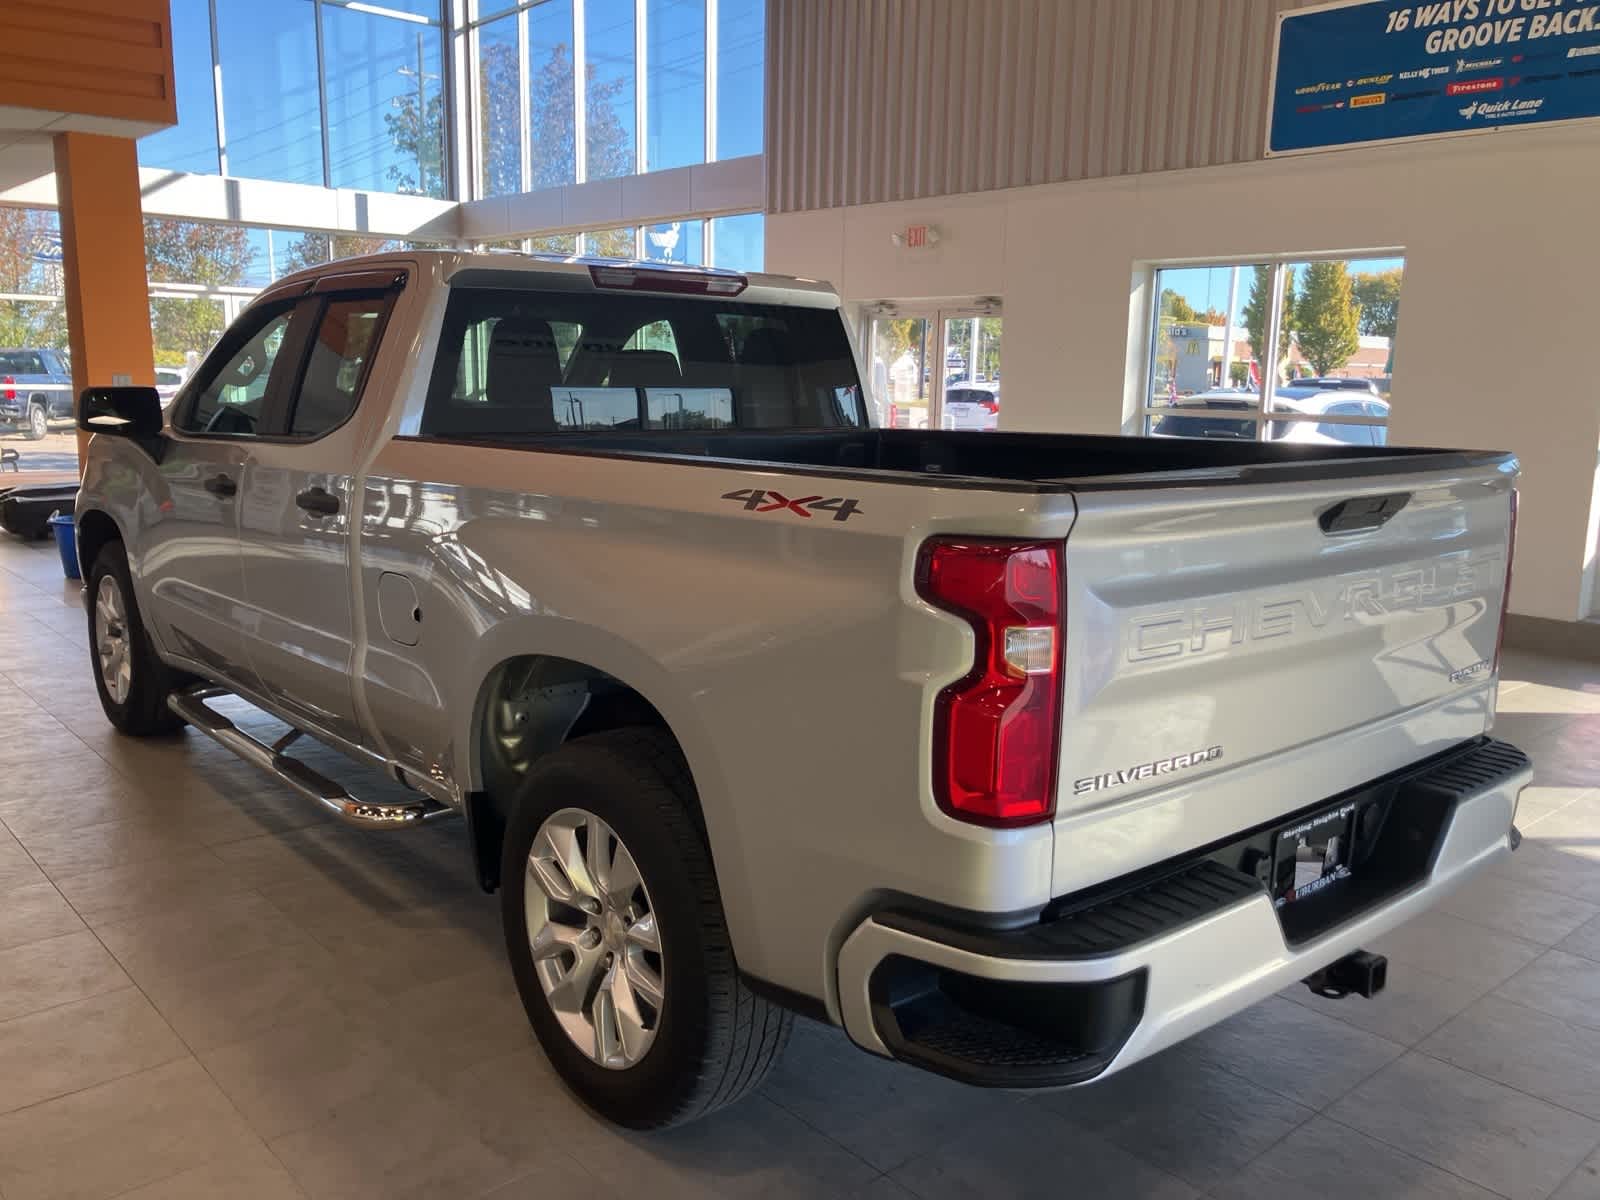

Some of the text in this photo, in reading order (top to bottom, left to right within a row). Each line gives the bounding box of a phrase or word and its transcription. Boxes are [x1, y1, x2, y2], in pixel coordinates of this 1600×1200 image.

[1386, 9, 1411, 33] 16
[1414, 0, 1481, 28] WAYS
[1425, 17, 1526, 54] GROOVE
[1477, 99, 1544, 116] Quick Lane
[908, 225, 928, 248] EXIT
[1126, 550, 1502, 664] CHEVROLET
[1073, 745, 1224, 795] SILVERADO
